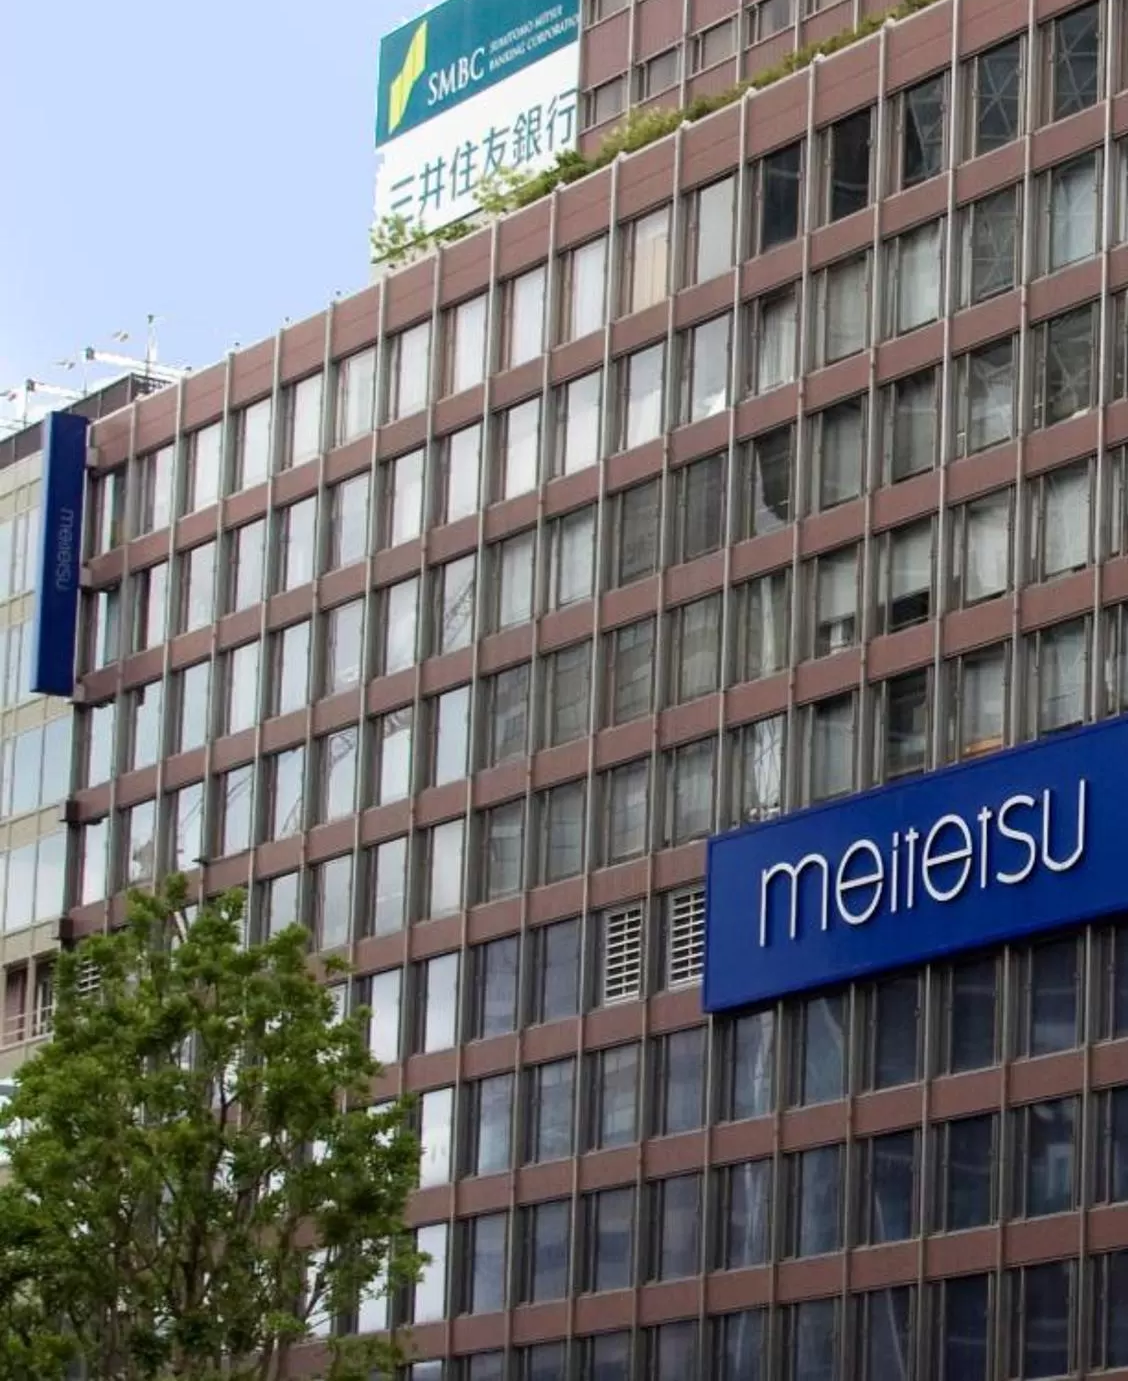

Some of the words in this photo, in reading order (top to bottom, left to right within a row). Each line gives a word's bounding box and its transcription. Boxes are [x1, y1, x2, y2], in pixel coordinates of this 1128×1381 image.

[427, 47, 485, 106] SMBC
[391, 88, 577, 222] 三井住友銀行
[56, 507, 74, 590] meitetsu
[759, 778, 1086, 948] meitetsu
